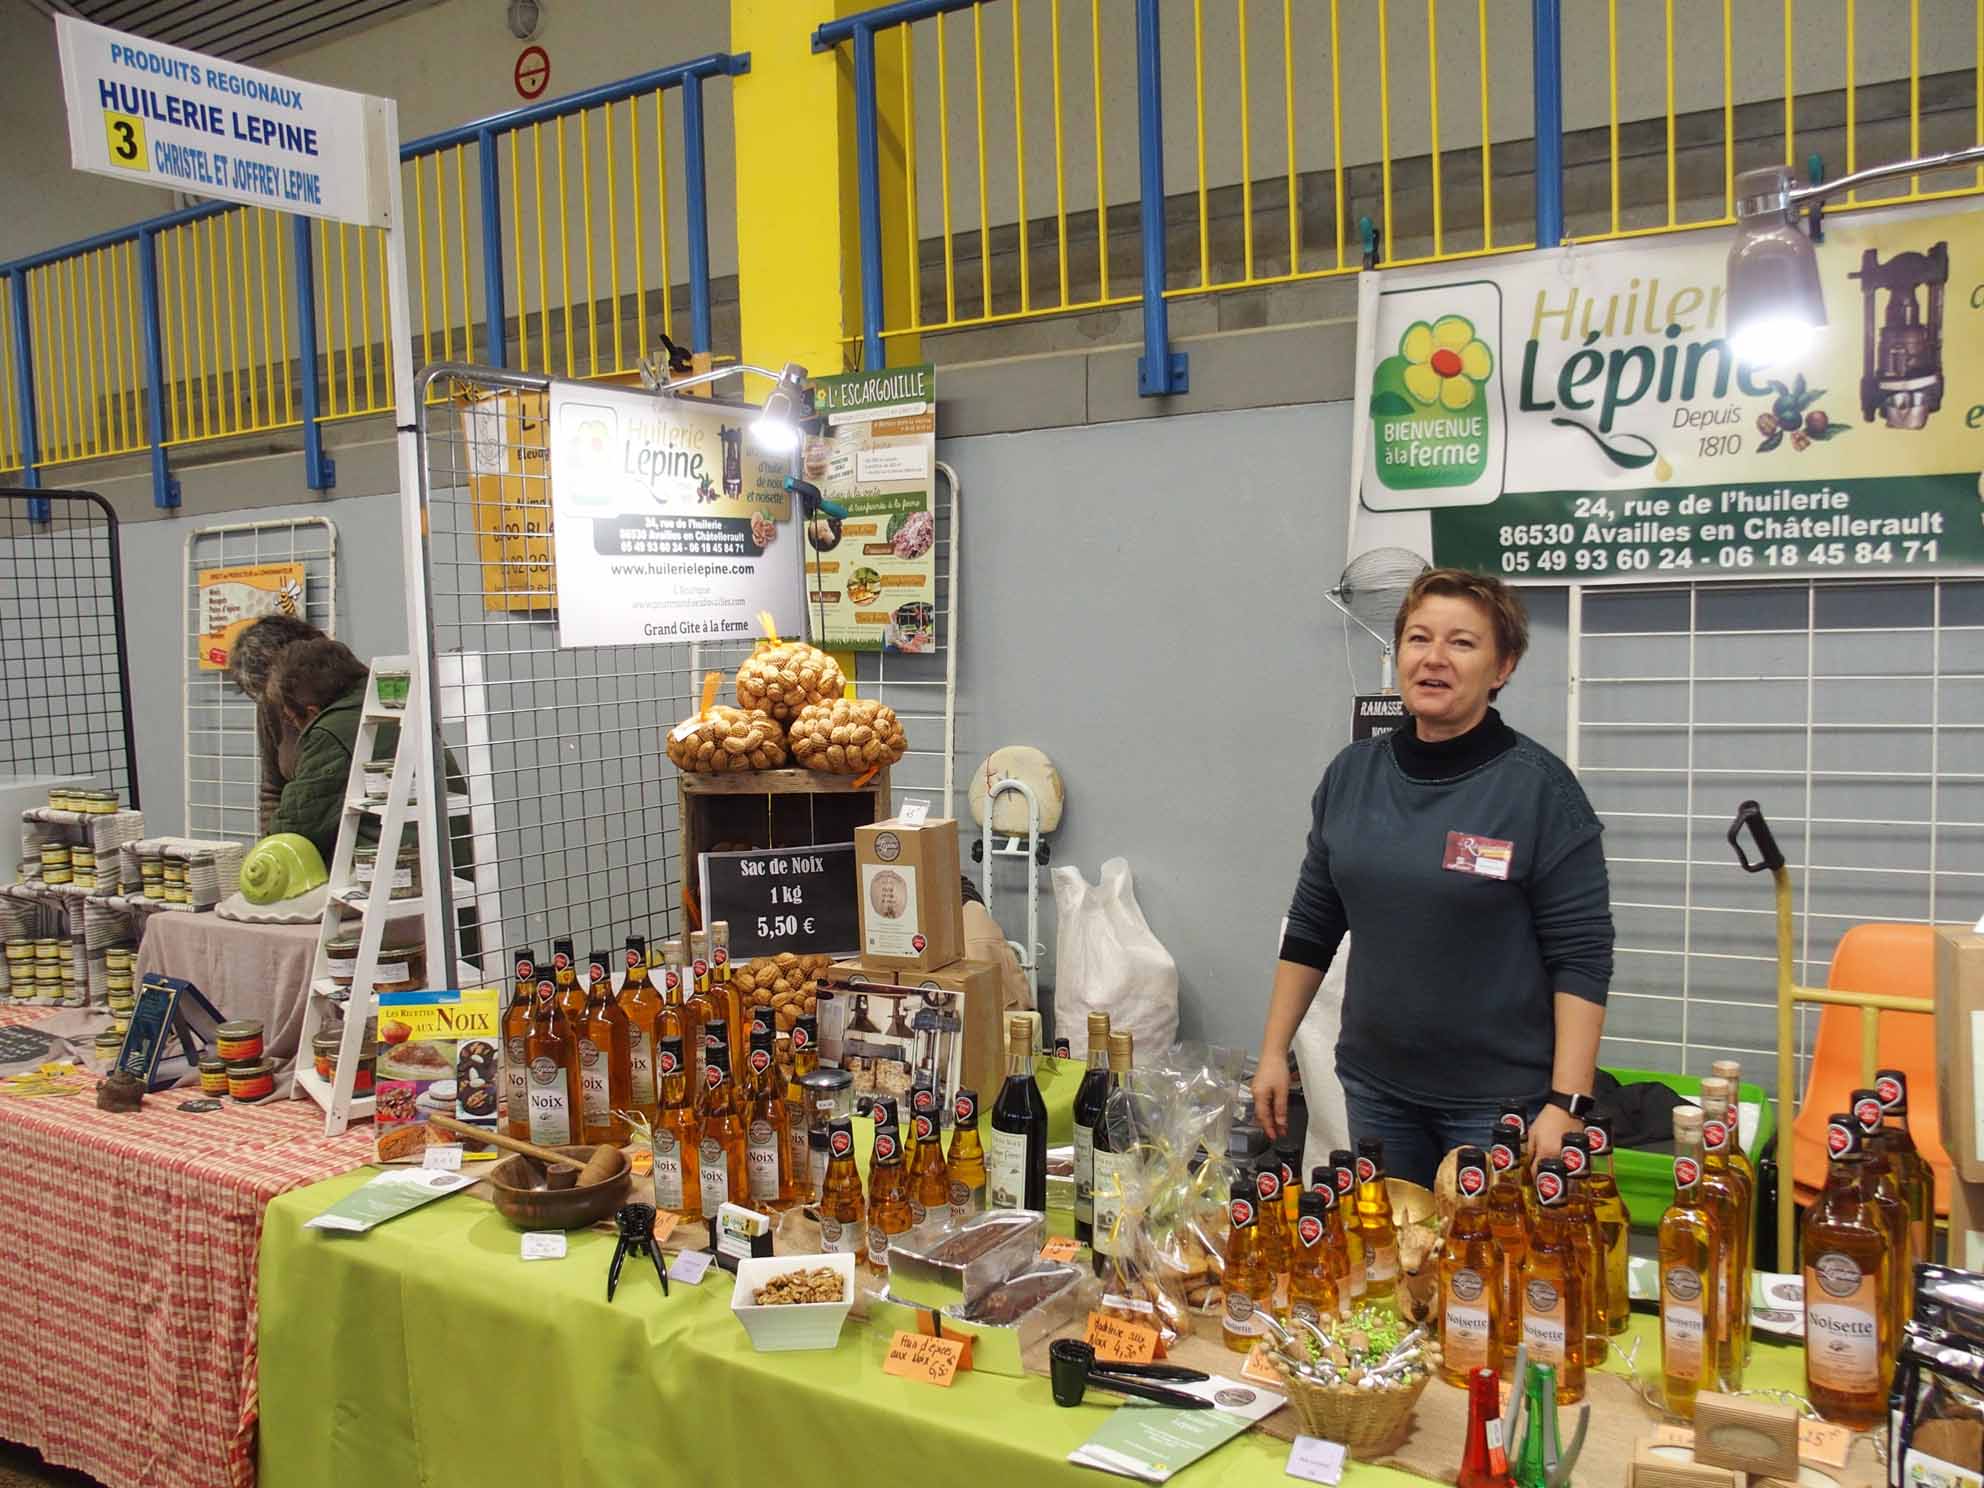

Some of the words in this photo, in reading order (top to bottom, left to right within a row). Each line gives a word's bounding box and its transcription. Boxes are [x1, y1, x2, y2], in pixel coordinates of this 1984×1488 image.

[110, 43, 201, 84] PRODUITS
[206, 69, 304, 110] REGIONAUX
[98, 78, 226, 136] HUILERIE
[232, 111, 319, 156] LEPINE
[113, 120, 138, 160] 3
[154, 140, 214, 184] CHRISTEL
[215, 155, 228, 187] ET
[232, 158, 282, 198] JOFFREY
[282, 170, 321, 205] LEPINE
[1531, 276, 1726, 341] Huiler
[1383, 416, 1483, 443] BIENVENUE
[1672, 404, 1743, 430] Depuis
[1409, 440, 1480, 468] ferme
[1697, 434, 1743, 459] 1810
[623, 439, 705, 488] Lépine
[1573, 497, 1616, 523] 24,
[1623, 498, 1671, 517] rue
[1678, 493, 1713, 515] de
[1720, 487, 1850, 513] l'huilerie
[1499, 523, 1575, 546] 86530
[1582, 521, 1691, 544] Availles
[1699, 523, 1736, 542] en
[1743, 511, 1944, 541] Châtellerault
[723, 543, 734, 553] 84
[735, 543, 744, 553] 71
[1501, 551, 1531, 572] 05
[1536, 550, 1568, 572] 49
[1574, 549, 1609, 571] 93
[1615, 548, 1650, 570] 60
[1657, 547, 1694, 569] 24
[1718, 546, 1755, 568] 06
[1763, 544, 1799, 567] 18
[1807, 543, 1846, 566] 45
[1854, 541, 1893, 564] 84
[1902, 539, 1939, 563] 71
[611, 562, 755, 578] www.huilerielepine.com
[644, 621, 678, 636] Grand
[702, 621, 708, 633] à
[710, 620, 719, 632] la
[720, 618, 749, 632] ferme
[1360, 701, 1404, 717] RAMASSE
[740, 858, 766, 877] Sac
[769, 857, 788, 876] de
[792, 855, 824, 874] Noix
[770, 886, 778, 905] 1
[782, 884, 803, 905] kg
[757, 914, 798, 939] 5,50
[802, 917, 817, 935] €
[584, 1076, 602, 1089] oix
[531, 1095, 563, 1108] Noix
[655, 1160, 677, 1172] Noix
[750, 1150, 775, 1163] Noix
[701, 1169, 723, 1182] Noix
[1447, 1311, 1488, 1329] Noisette
[1809, 1311, 1873, 1334] Noisette
